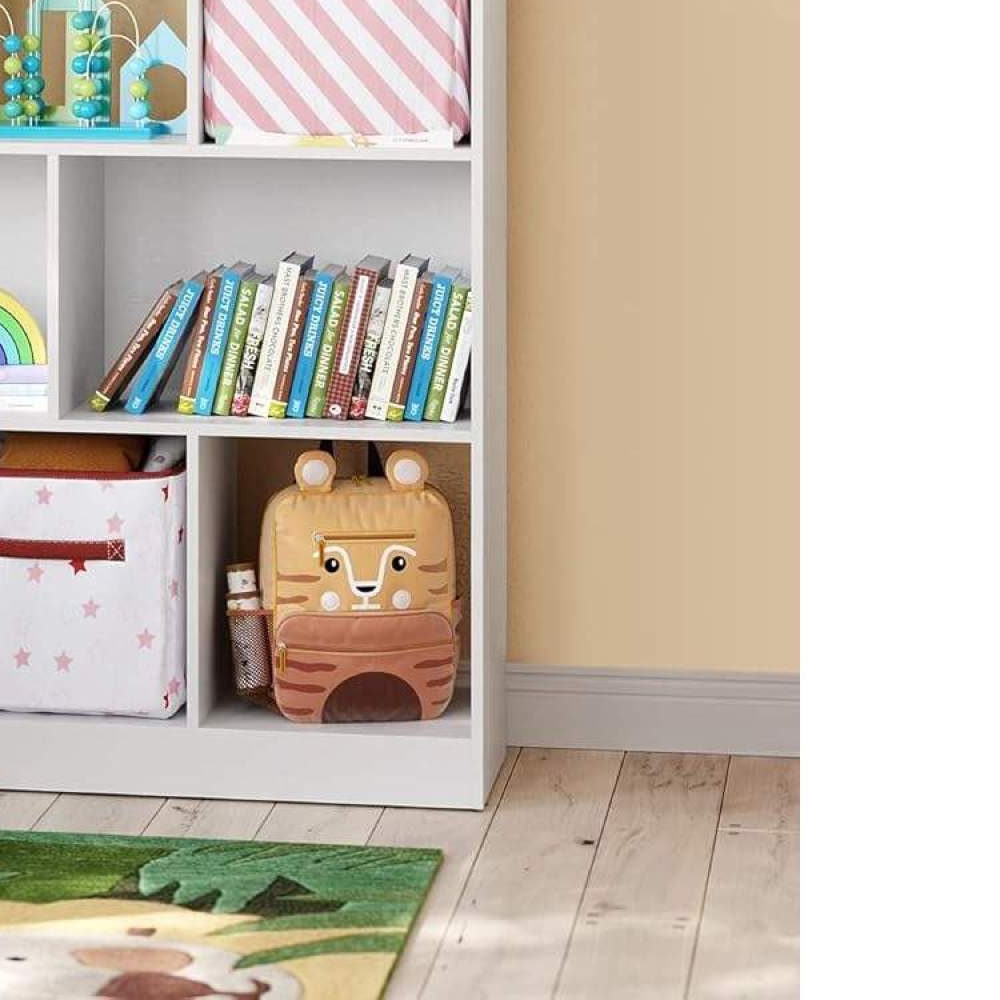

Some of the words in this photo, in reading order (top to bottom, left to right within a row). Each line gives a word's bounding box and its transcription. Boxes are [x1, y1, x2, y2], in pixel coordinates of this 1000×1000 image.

[176, 288, 194, 318] JUICY
[221, 279, 235, 311] JUICY
[236, 287, 251, 326] SALAD
[314, 281, 327, 313] JUICY
[330, 290, 344, 327] SALAD
[432, 283, 446, 316] JUICY
[447, 292, 463, 329] SALAD
[156, 319, 180, 360] DRINKS
[211, 312, 227, 355] DRINKS
[244, 333, 260, 369] FRESH
[304, 313, 320, 357] DRINKS
[360, 333, 378, 373] FRESH
[421, 316, 438, 360] DRINKS
[223, 342, 240, 386] DINNER
[315, 344, 333, 388] DINNER
[433, 347, 451, 391] DINNER
